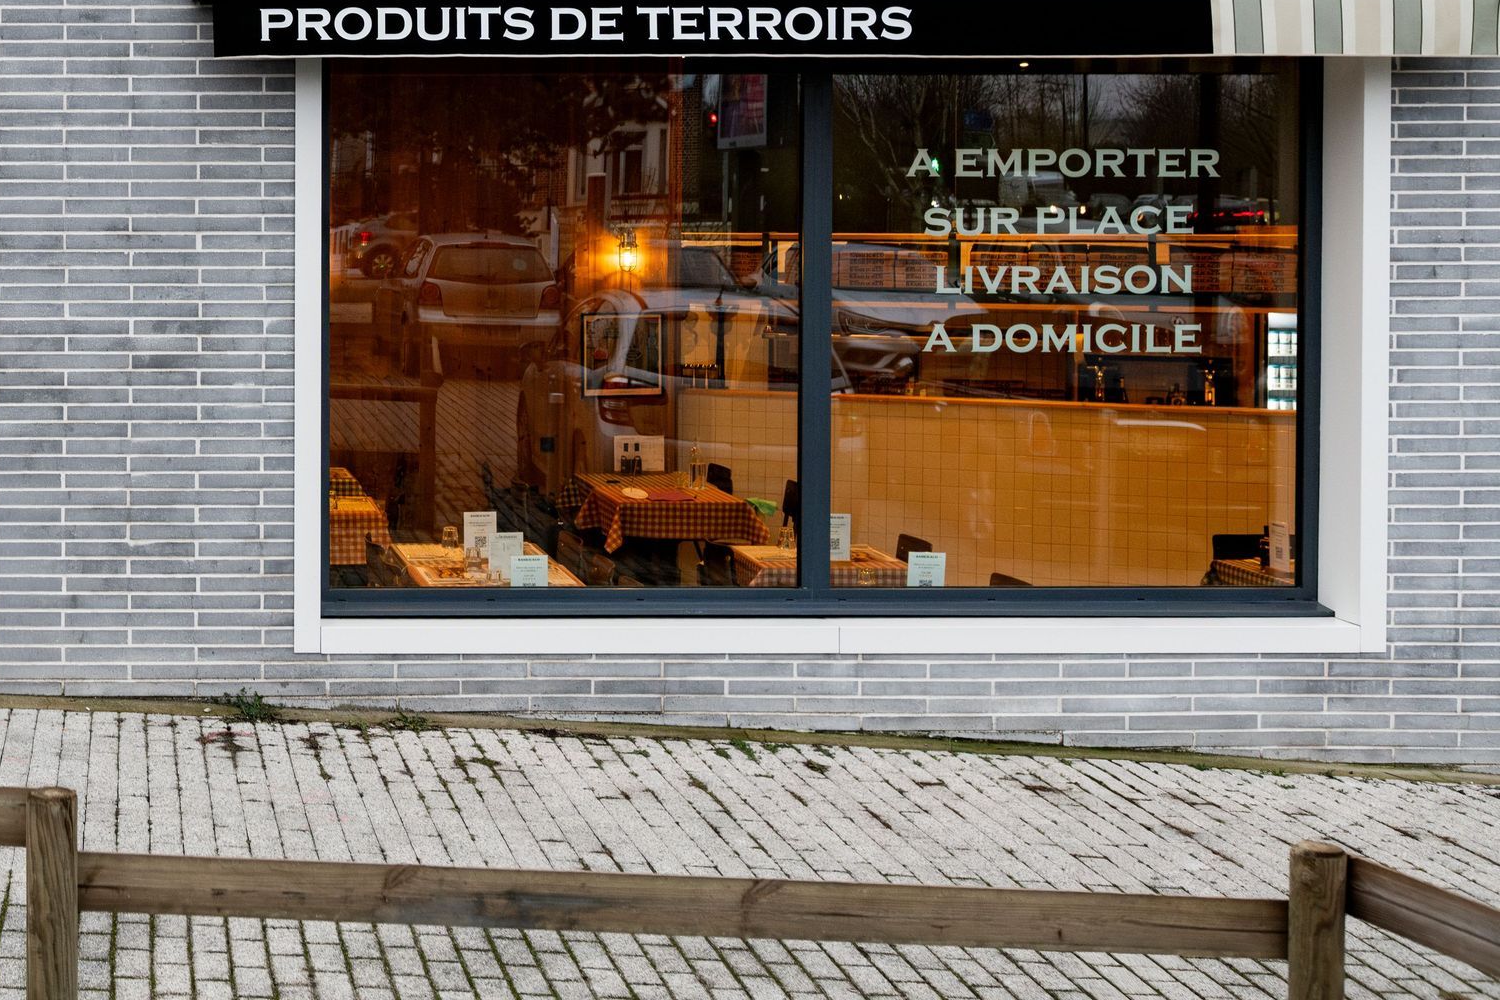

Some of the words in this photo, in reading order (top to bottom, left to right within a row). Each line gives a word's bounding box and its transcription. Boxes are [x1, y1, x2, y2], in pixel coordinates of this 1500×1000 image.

[259, 5, 535, 42] PRODUITS
[550, 5, 624, 42] DE
[636, 5, 913, 41] TERROIRS
[906, 148, 940, 178] A
[955, 147, 1221, 178] EMPORTER
[924, 206, 1020, 237] SUR
[1035, 204, 1195, 236] PLACE
[934, 264, 1194, 296] LIVRAISON
[922, 323, 957, 353] A
[971, 323, 1203, 354] DOMICILE
